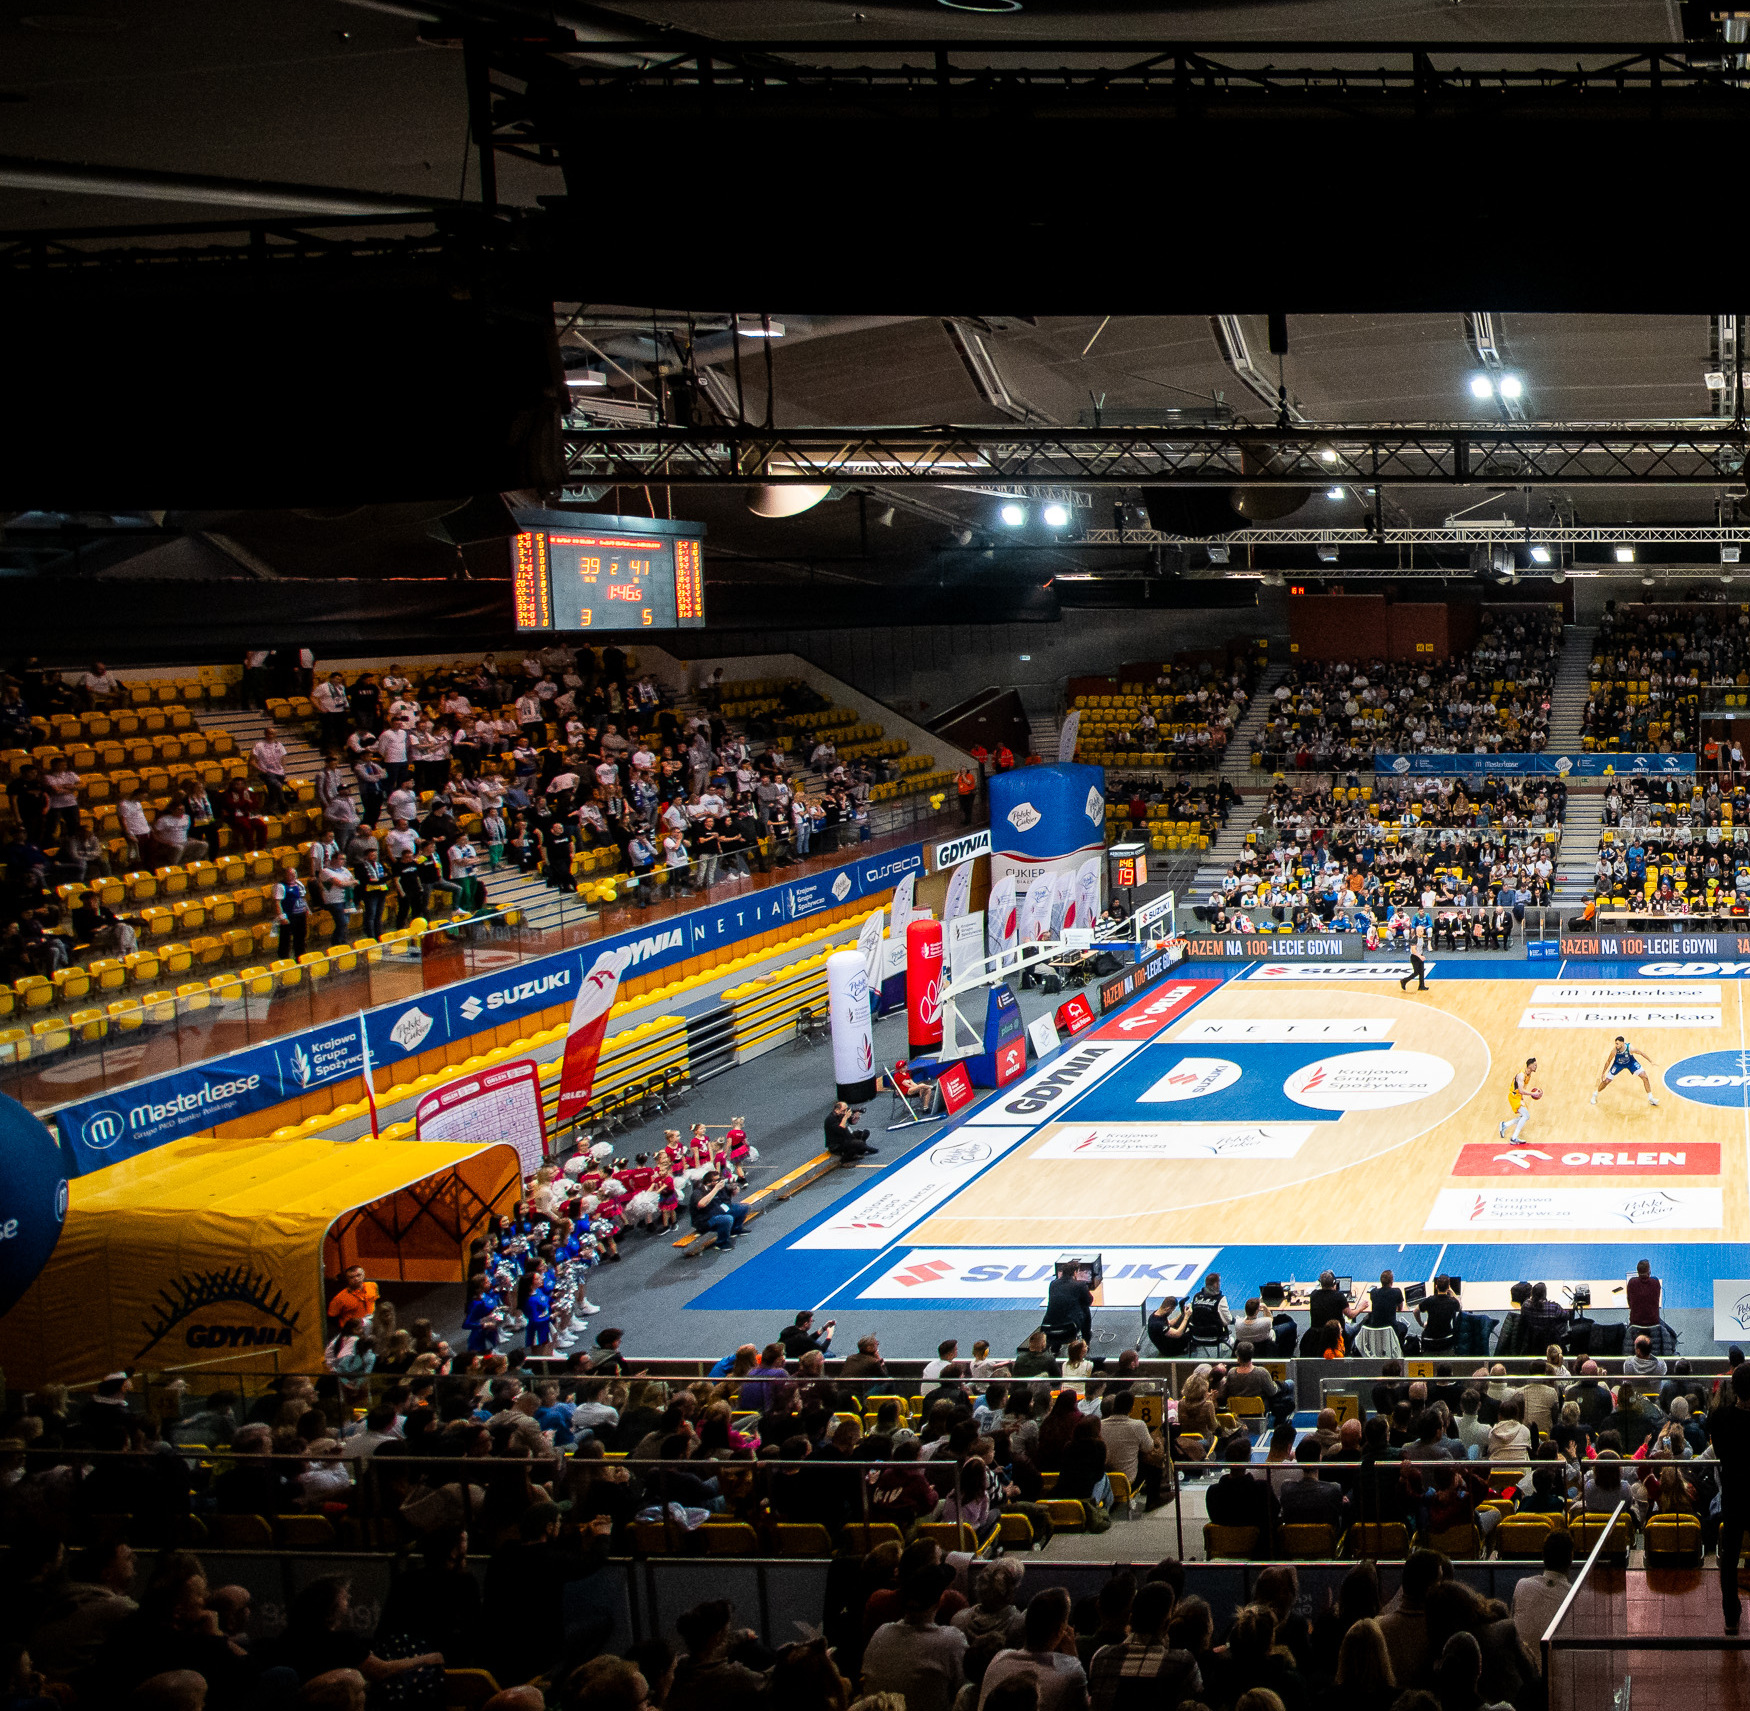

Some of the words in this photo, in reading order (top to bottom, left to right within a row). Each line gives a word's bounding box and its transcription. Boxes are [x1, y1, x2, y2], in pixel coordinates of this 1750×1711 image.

[580, 557, 600, 574] 39
[610, 563, 618, 575] 2
[630, 560, 650, 575] 41
[581, 609, 592, 626] 3
[643, 609, 652, 625] 5
[938, 829, 990, 866] GDYNIA
[866, 855, 922, 882] asseco
[1119, 858, 1133, 868] 1:46
[1118, 868, 1134, 885] 19
[1148, 902, 1170, 920] SUZUKI
[1226, 940, 1243, 955] NA
[1246, 940, 1305, 955] 100-LECIE
[1307, 940, 1342, 955] GDYNI
[1601, 939, 1618, 955] NA
[1620, 939, 1680, 955] 100-LECIE
[1682, 938, 1718, 954] GDYNI
[1124, 976, 1134, 994] NA
[1134, 957, 1162, 988] 100-LECIE
[1300, 967, 1412, 975] SUZUK
[485, 969, 571, 1010] SUZUKI
[1592, 988, 1703, 997] Masterlease
[1144, 986, 1197, 1014] ORLEN
[1584, 1012, 1638, 1022] Bank
[1646, 1012, 1715, 1022] Pekao
[311, 1032, 357, 1053] Krajowa
[313, 1047, 348, 1065] Grupa
[315, 1050, 375, 1076] Spożywca
[1005, 1048, 1114, 1114] GDYNIA
[1192, 1065, 1229, 1094] SUZUKI
[1329, 1082, 1428, 1090] Spożywcza
[130, 1073, 260, 1127] Masterlease
[1561, 1152, 1687, 1166] ORLEN
[968, 1264, 1198, 1283] SUUKI
[186, 1324, 293, 1349] GDYNIA
[1270, 1367, 1279, 1380] 6
[1417, 1369, 1426, 1378] 5
[1141, 1407, 1152, 1423] 8
[1336, 1406, 1348, 1422] 7
